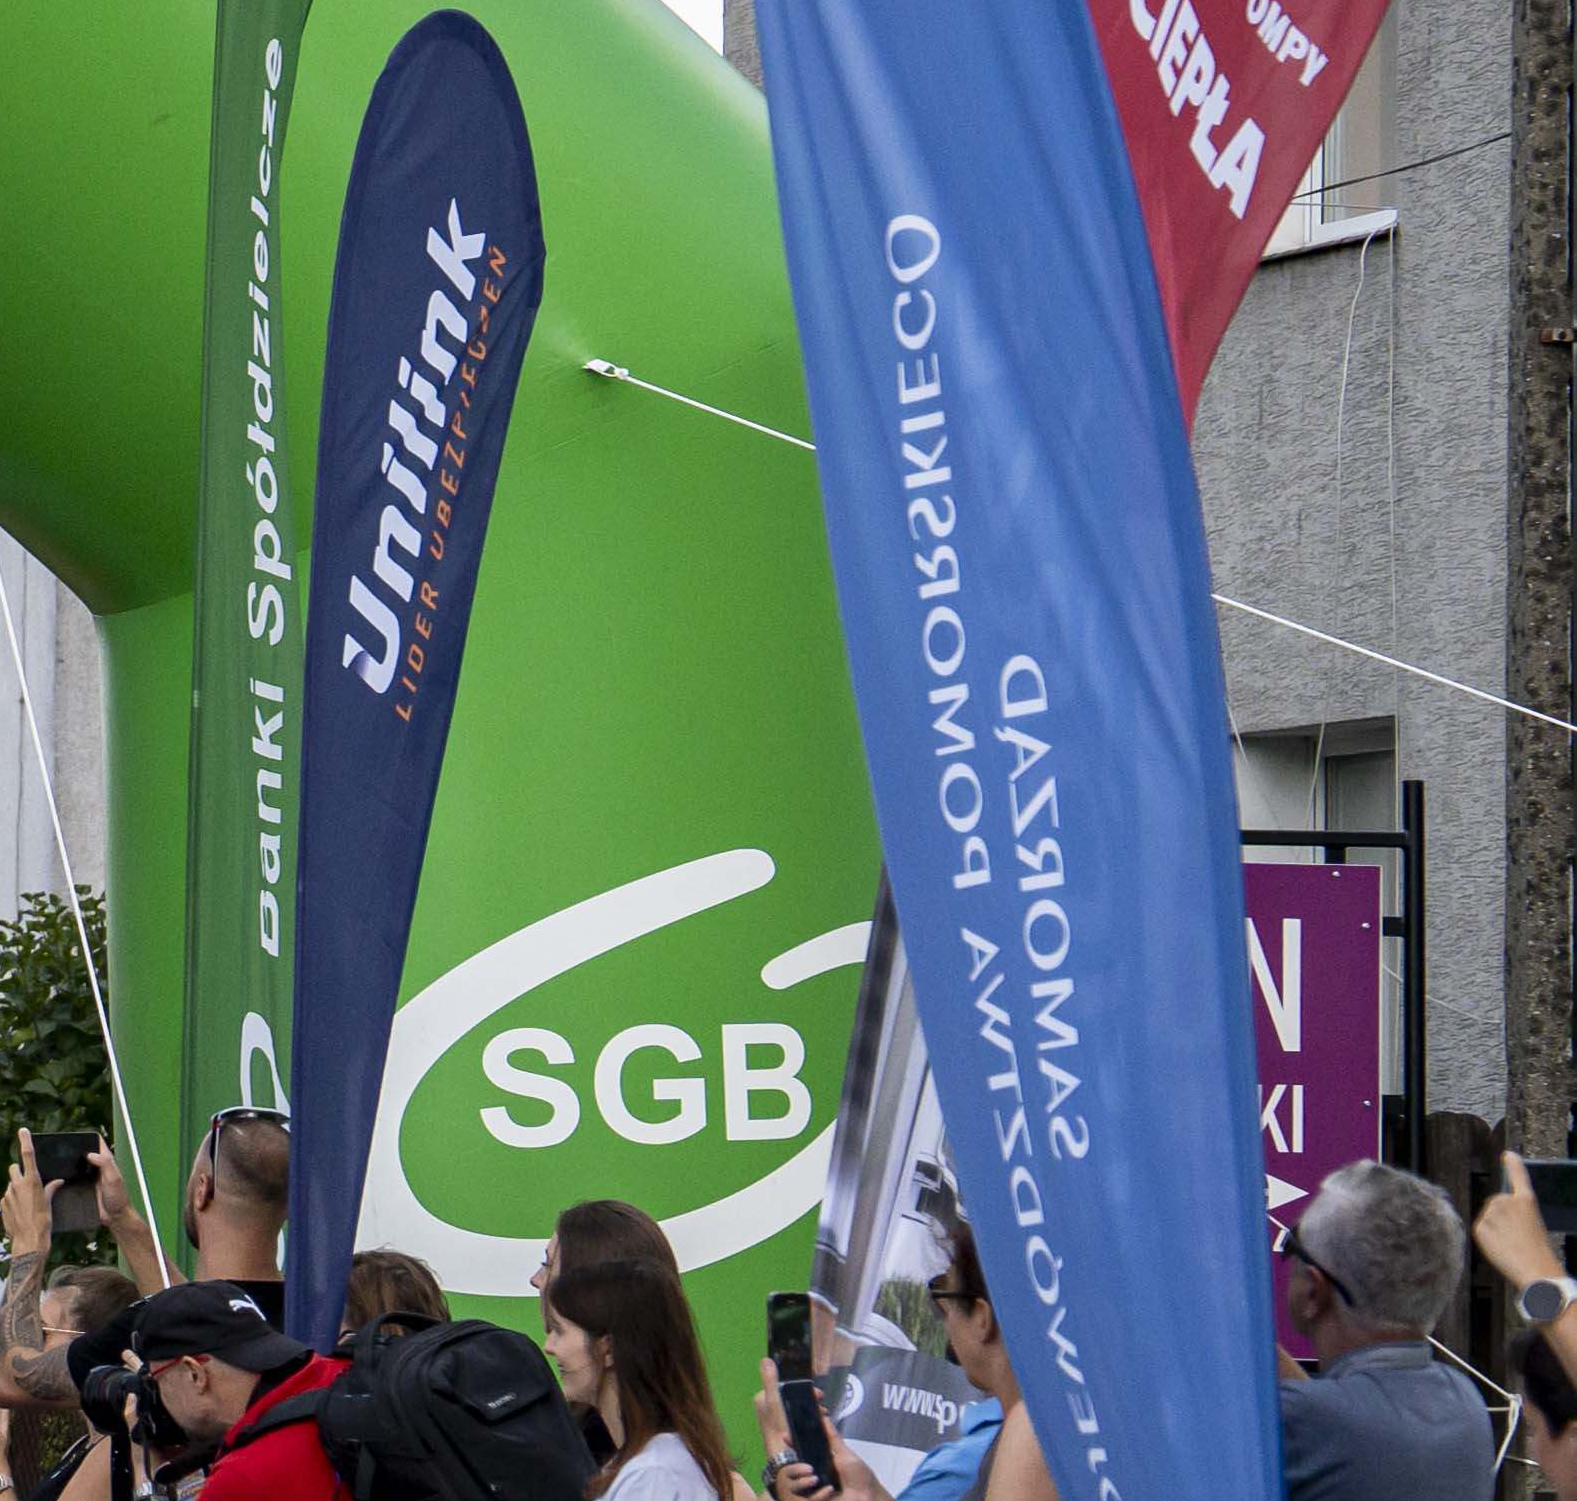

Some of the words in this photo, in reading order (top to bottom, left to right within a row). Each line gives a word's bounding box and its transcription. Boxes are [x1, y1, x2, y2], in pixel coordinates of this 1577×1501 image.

[246, 38, 288, 647] Spółdzielcze
[342, 198, 486, 695] Unilink
[396, 580, 439, 722] LIDER
[479, 1023, 814, 1149] SGB
